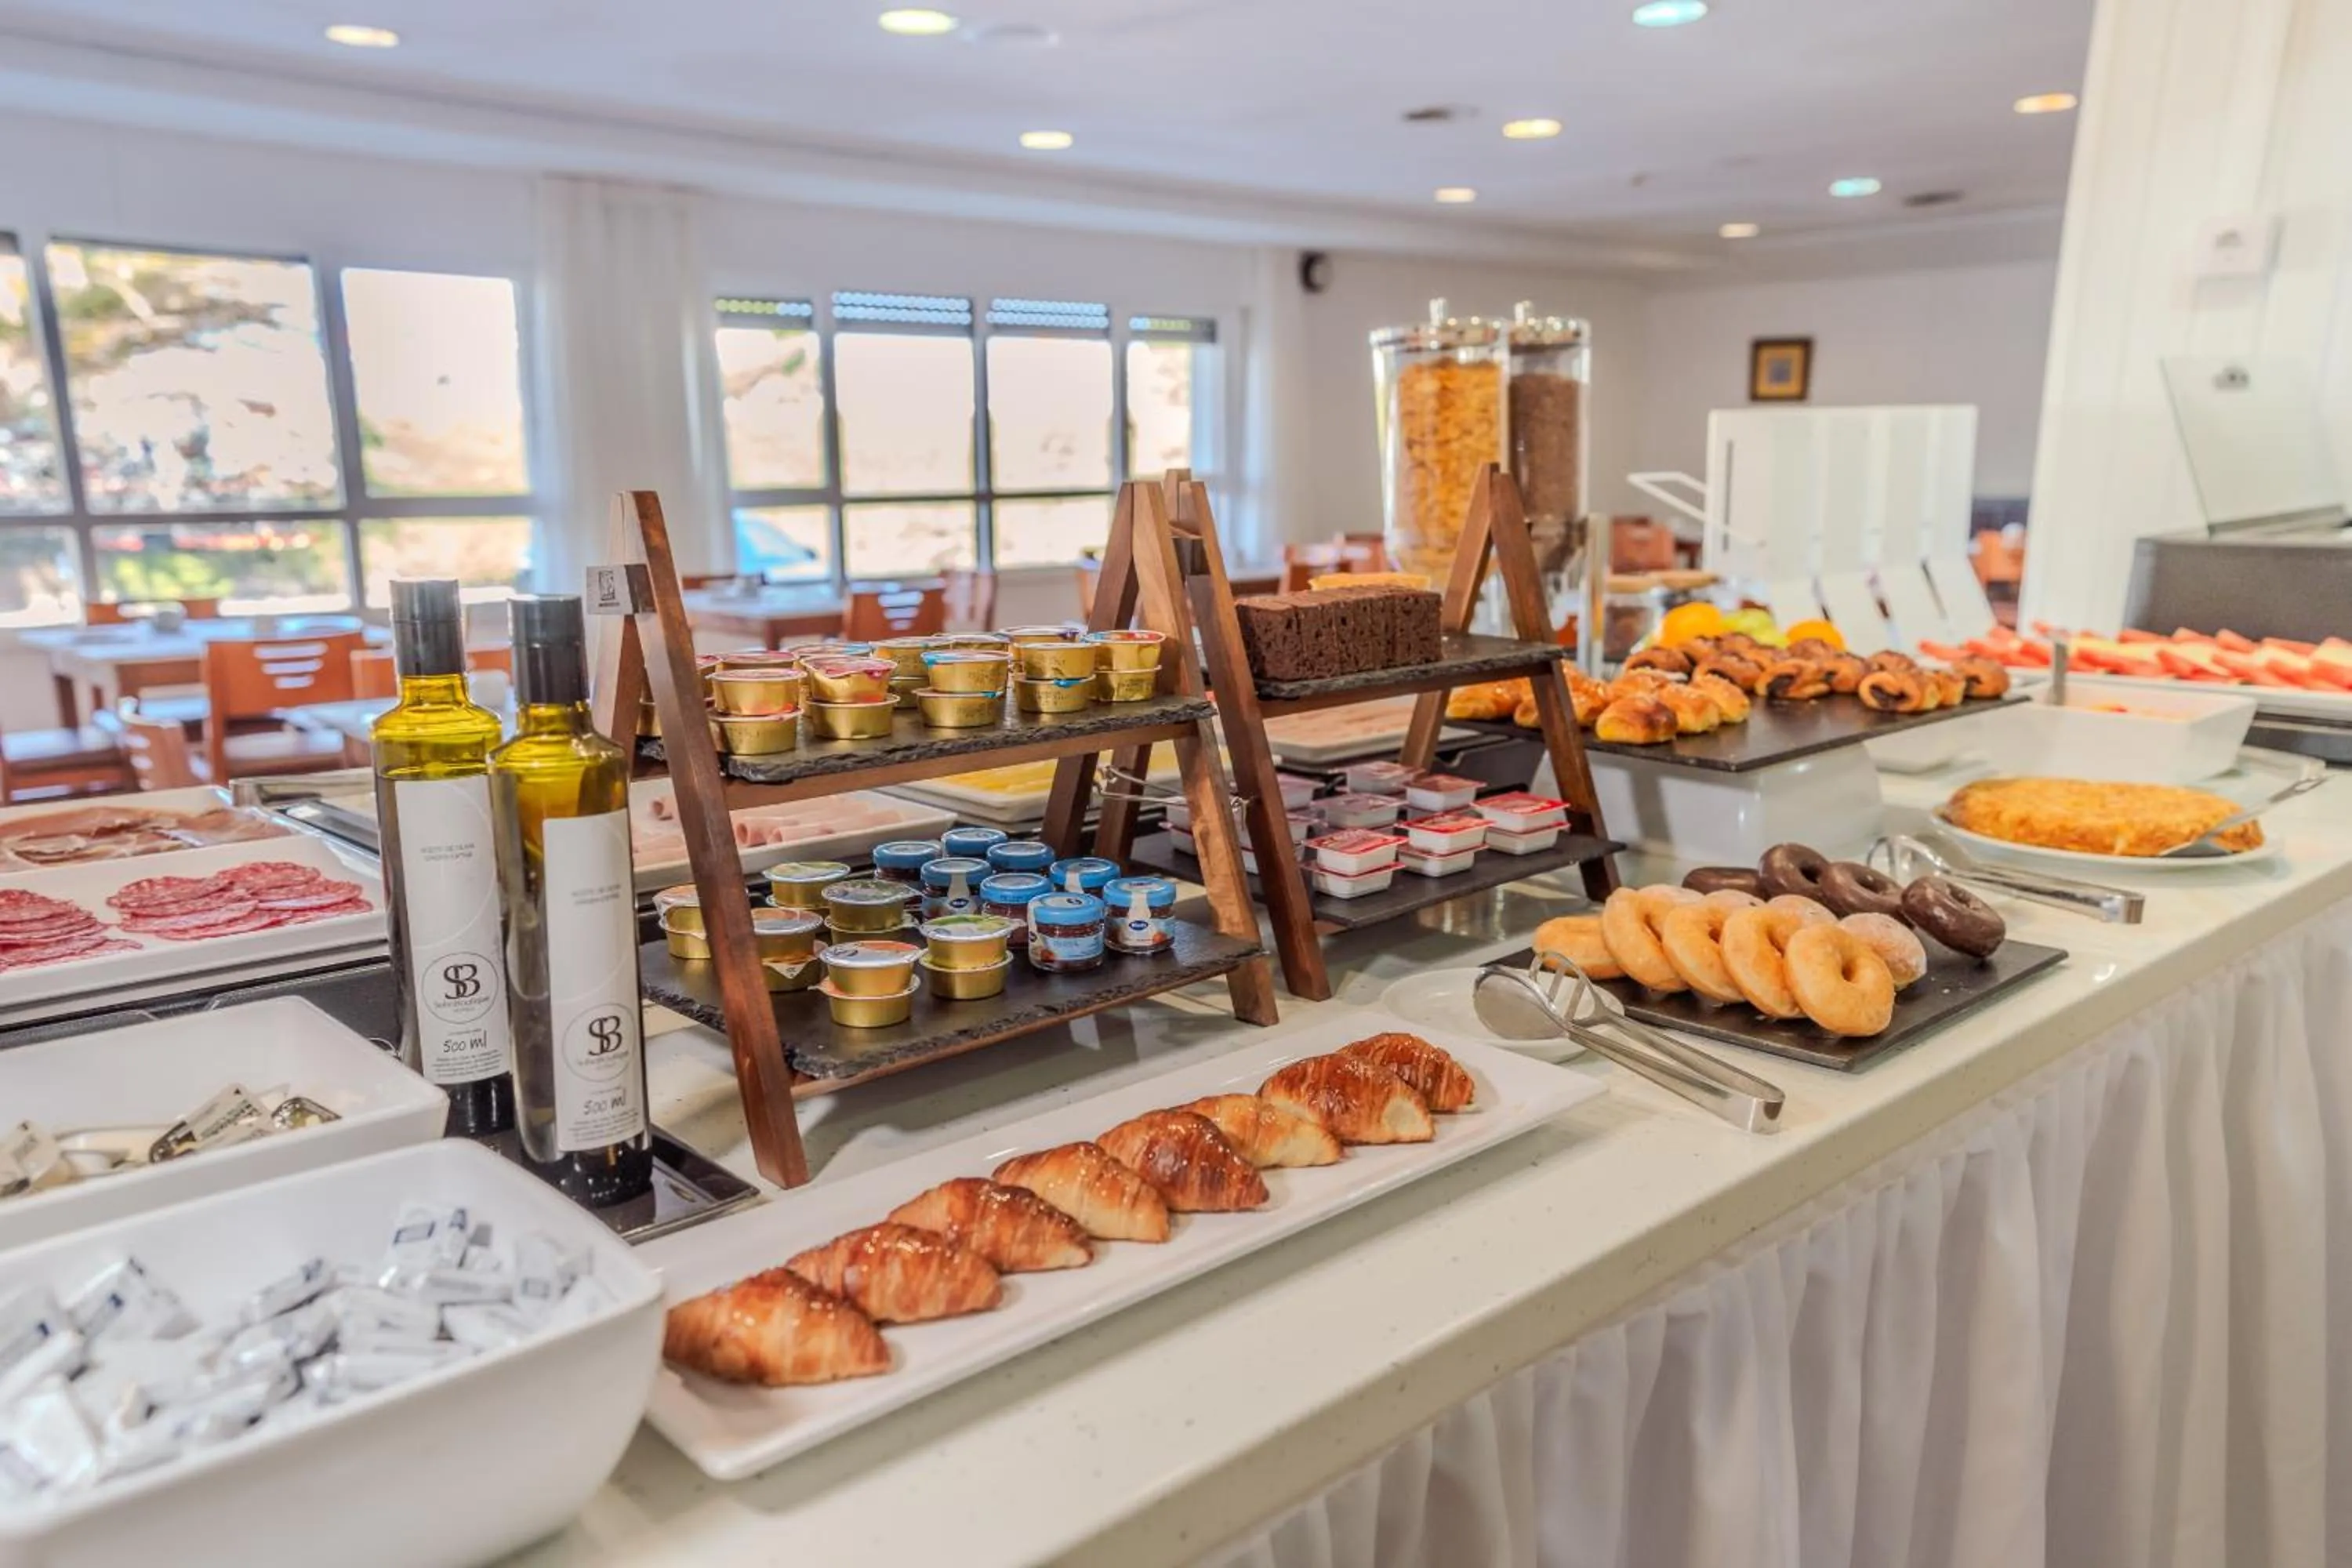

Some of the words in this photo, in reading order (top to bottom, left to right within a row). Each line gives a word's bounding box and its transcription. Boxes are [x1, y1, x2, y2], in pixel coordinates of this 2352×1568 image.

[443, 964, 481, 1000] SB
[443, 1039, 466, 1053] 500
[470, 1029, 487, 1050] ml
[588, 1015, 622, 1056] SB
